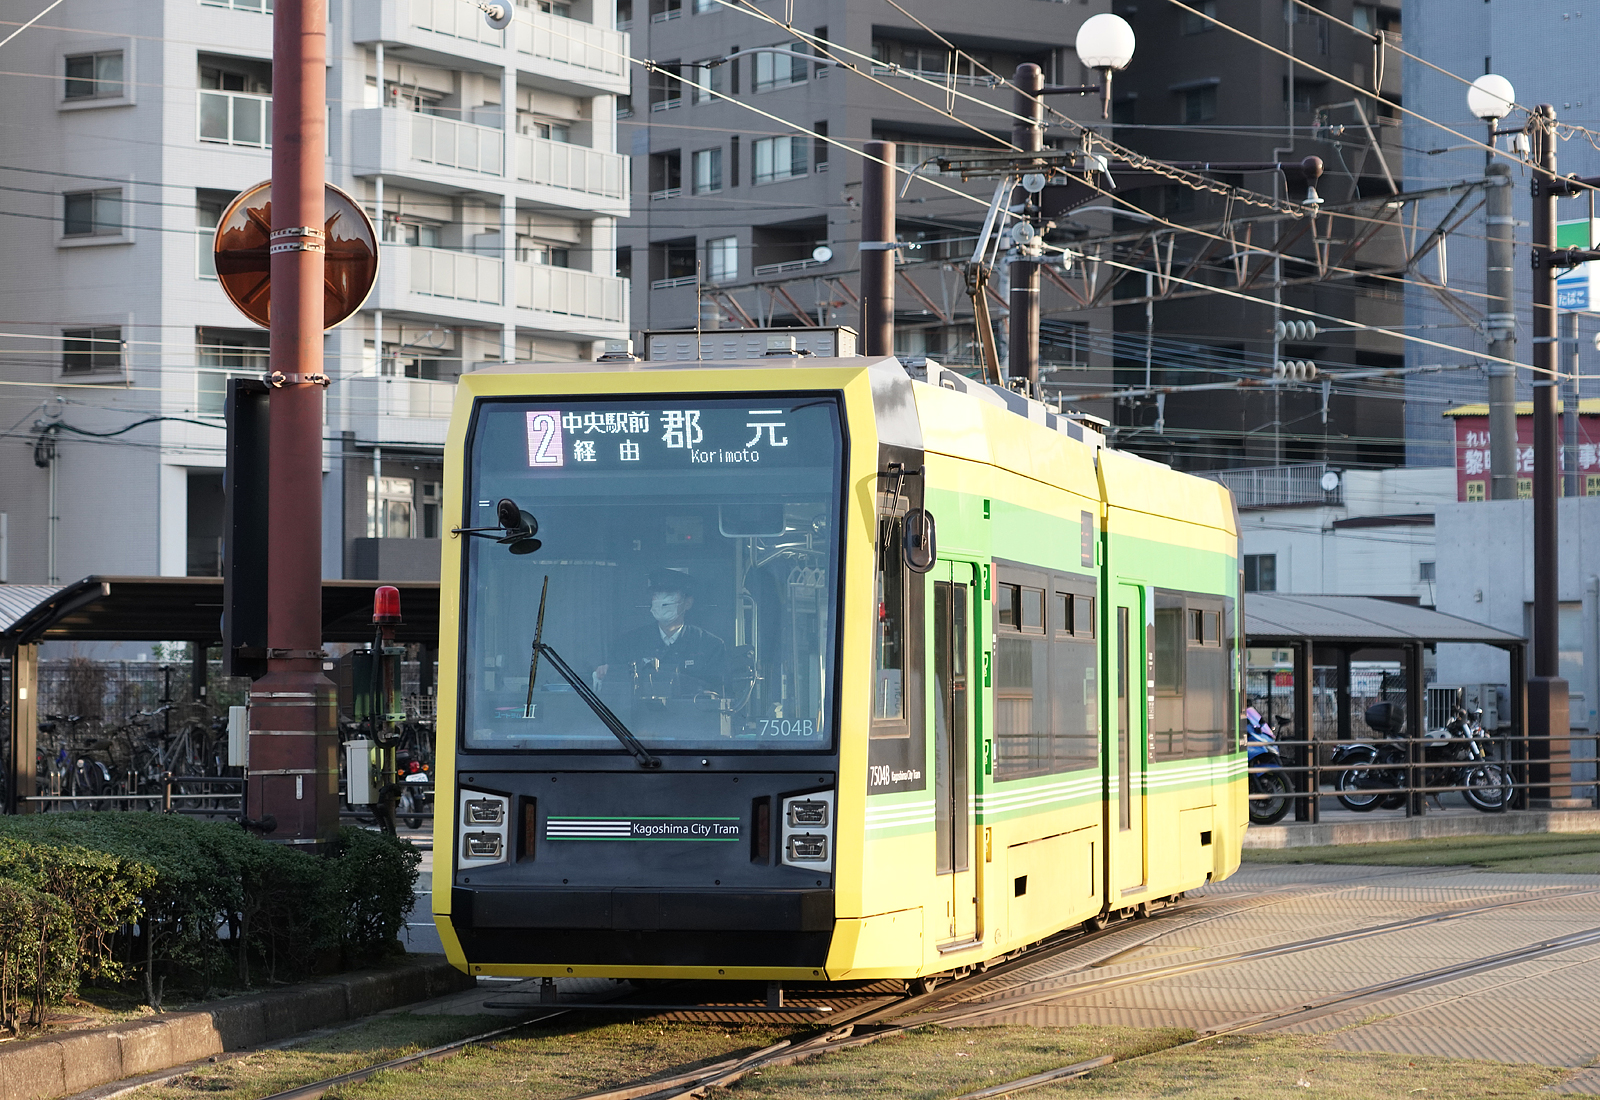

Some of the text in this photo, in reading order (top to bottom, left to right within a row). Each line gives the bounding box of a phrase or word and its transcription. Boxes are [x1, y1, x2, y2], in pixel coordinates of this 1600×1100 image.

[1558, 290, 1585, 306] たばこ
[562, 411, 649, 434] 中央駅前
[533, 414, 557, 463] 2
[691, 448, 759, 463] Korimoto
[759, 719, 813, 736] 7504B
[869, 764, 890, 787] 7504B
[633, 823, 739, 836] Kagoshima City Tram
